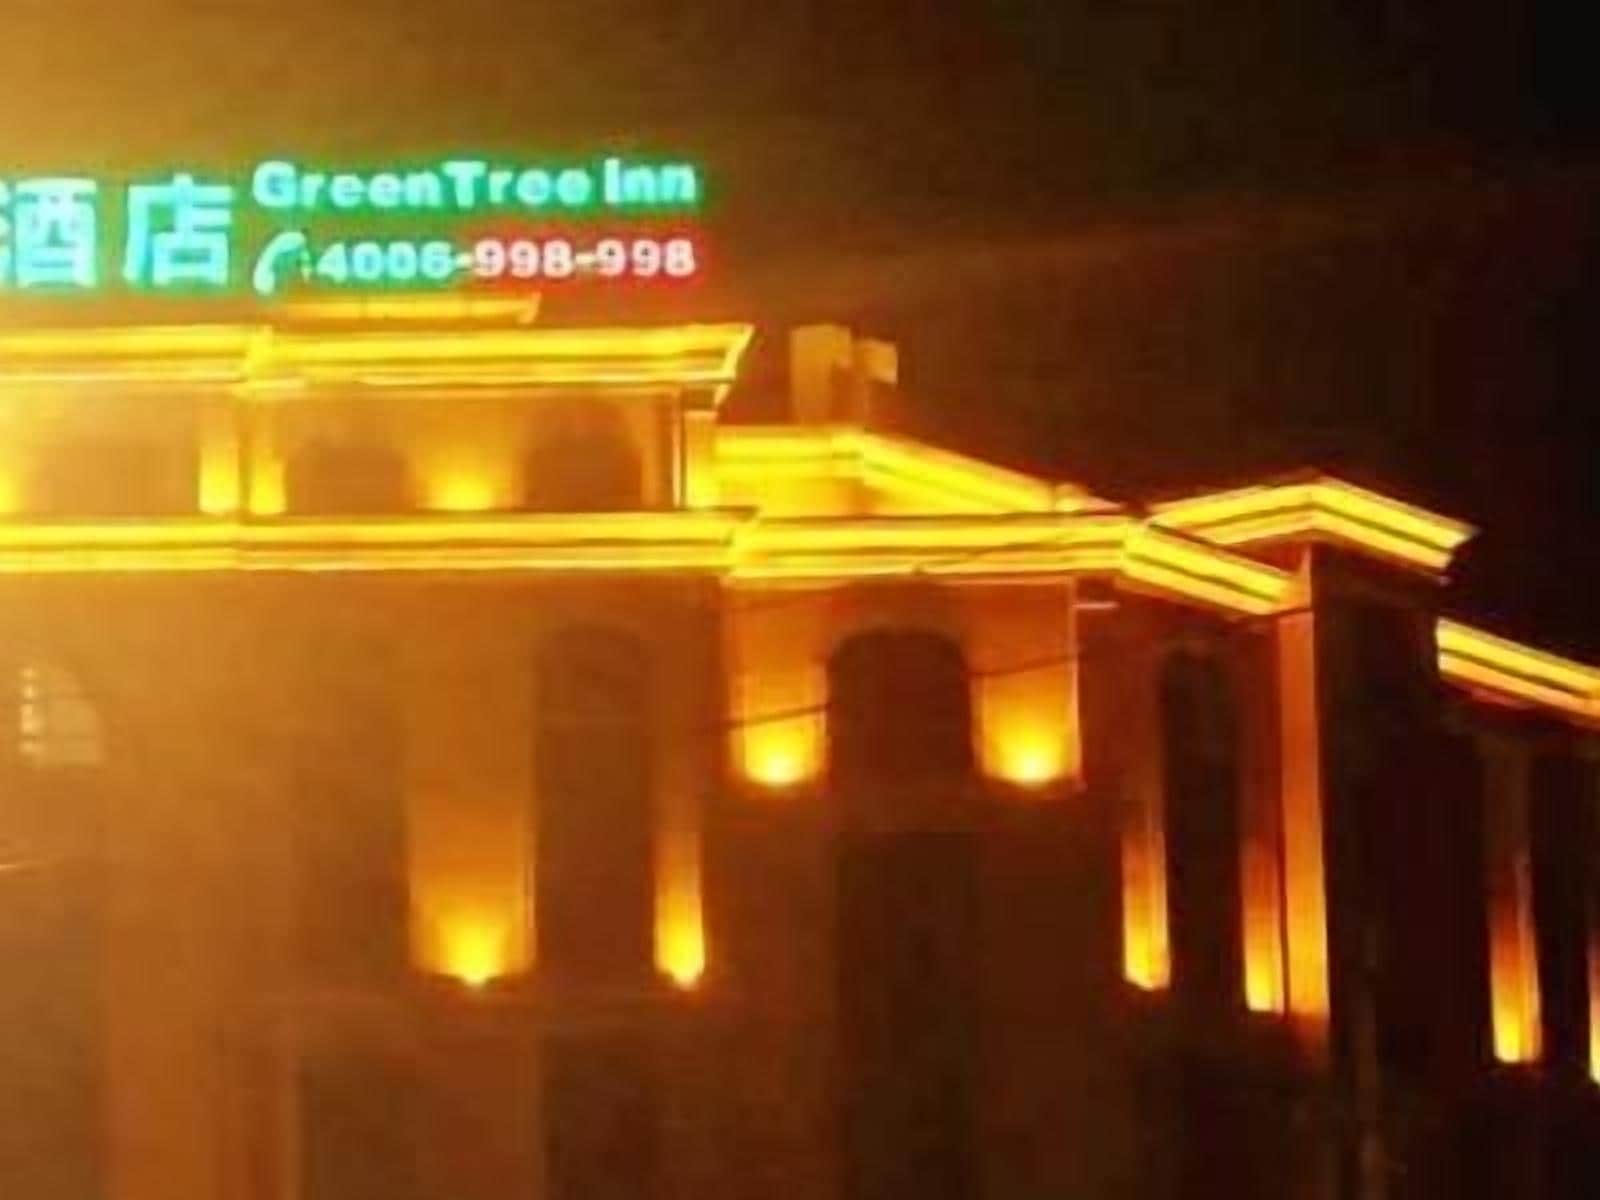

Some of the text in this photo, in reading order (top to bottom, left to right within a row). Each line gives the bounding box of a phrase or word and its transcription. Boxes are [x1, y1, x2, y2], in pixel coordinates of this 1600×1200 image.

[253, 157, 698, 208] GreenTree Inn
[316, 239, 697, 282] 4006-998-998
